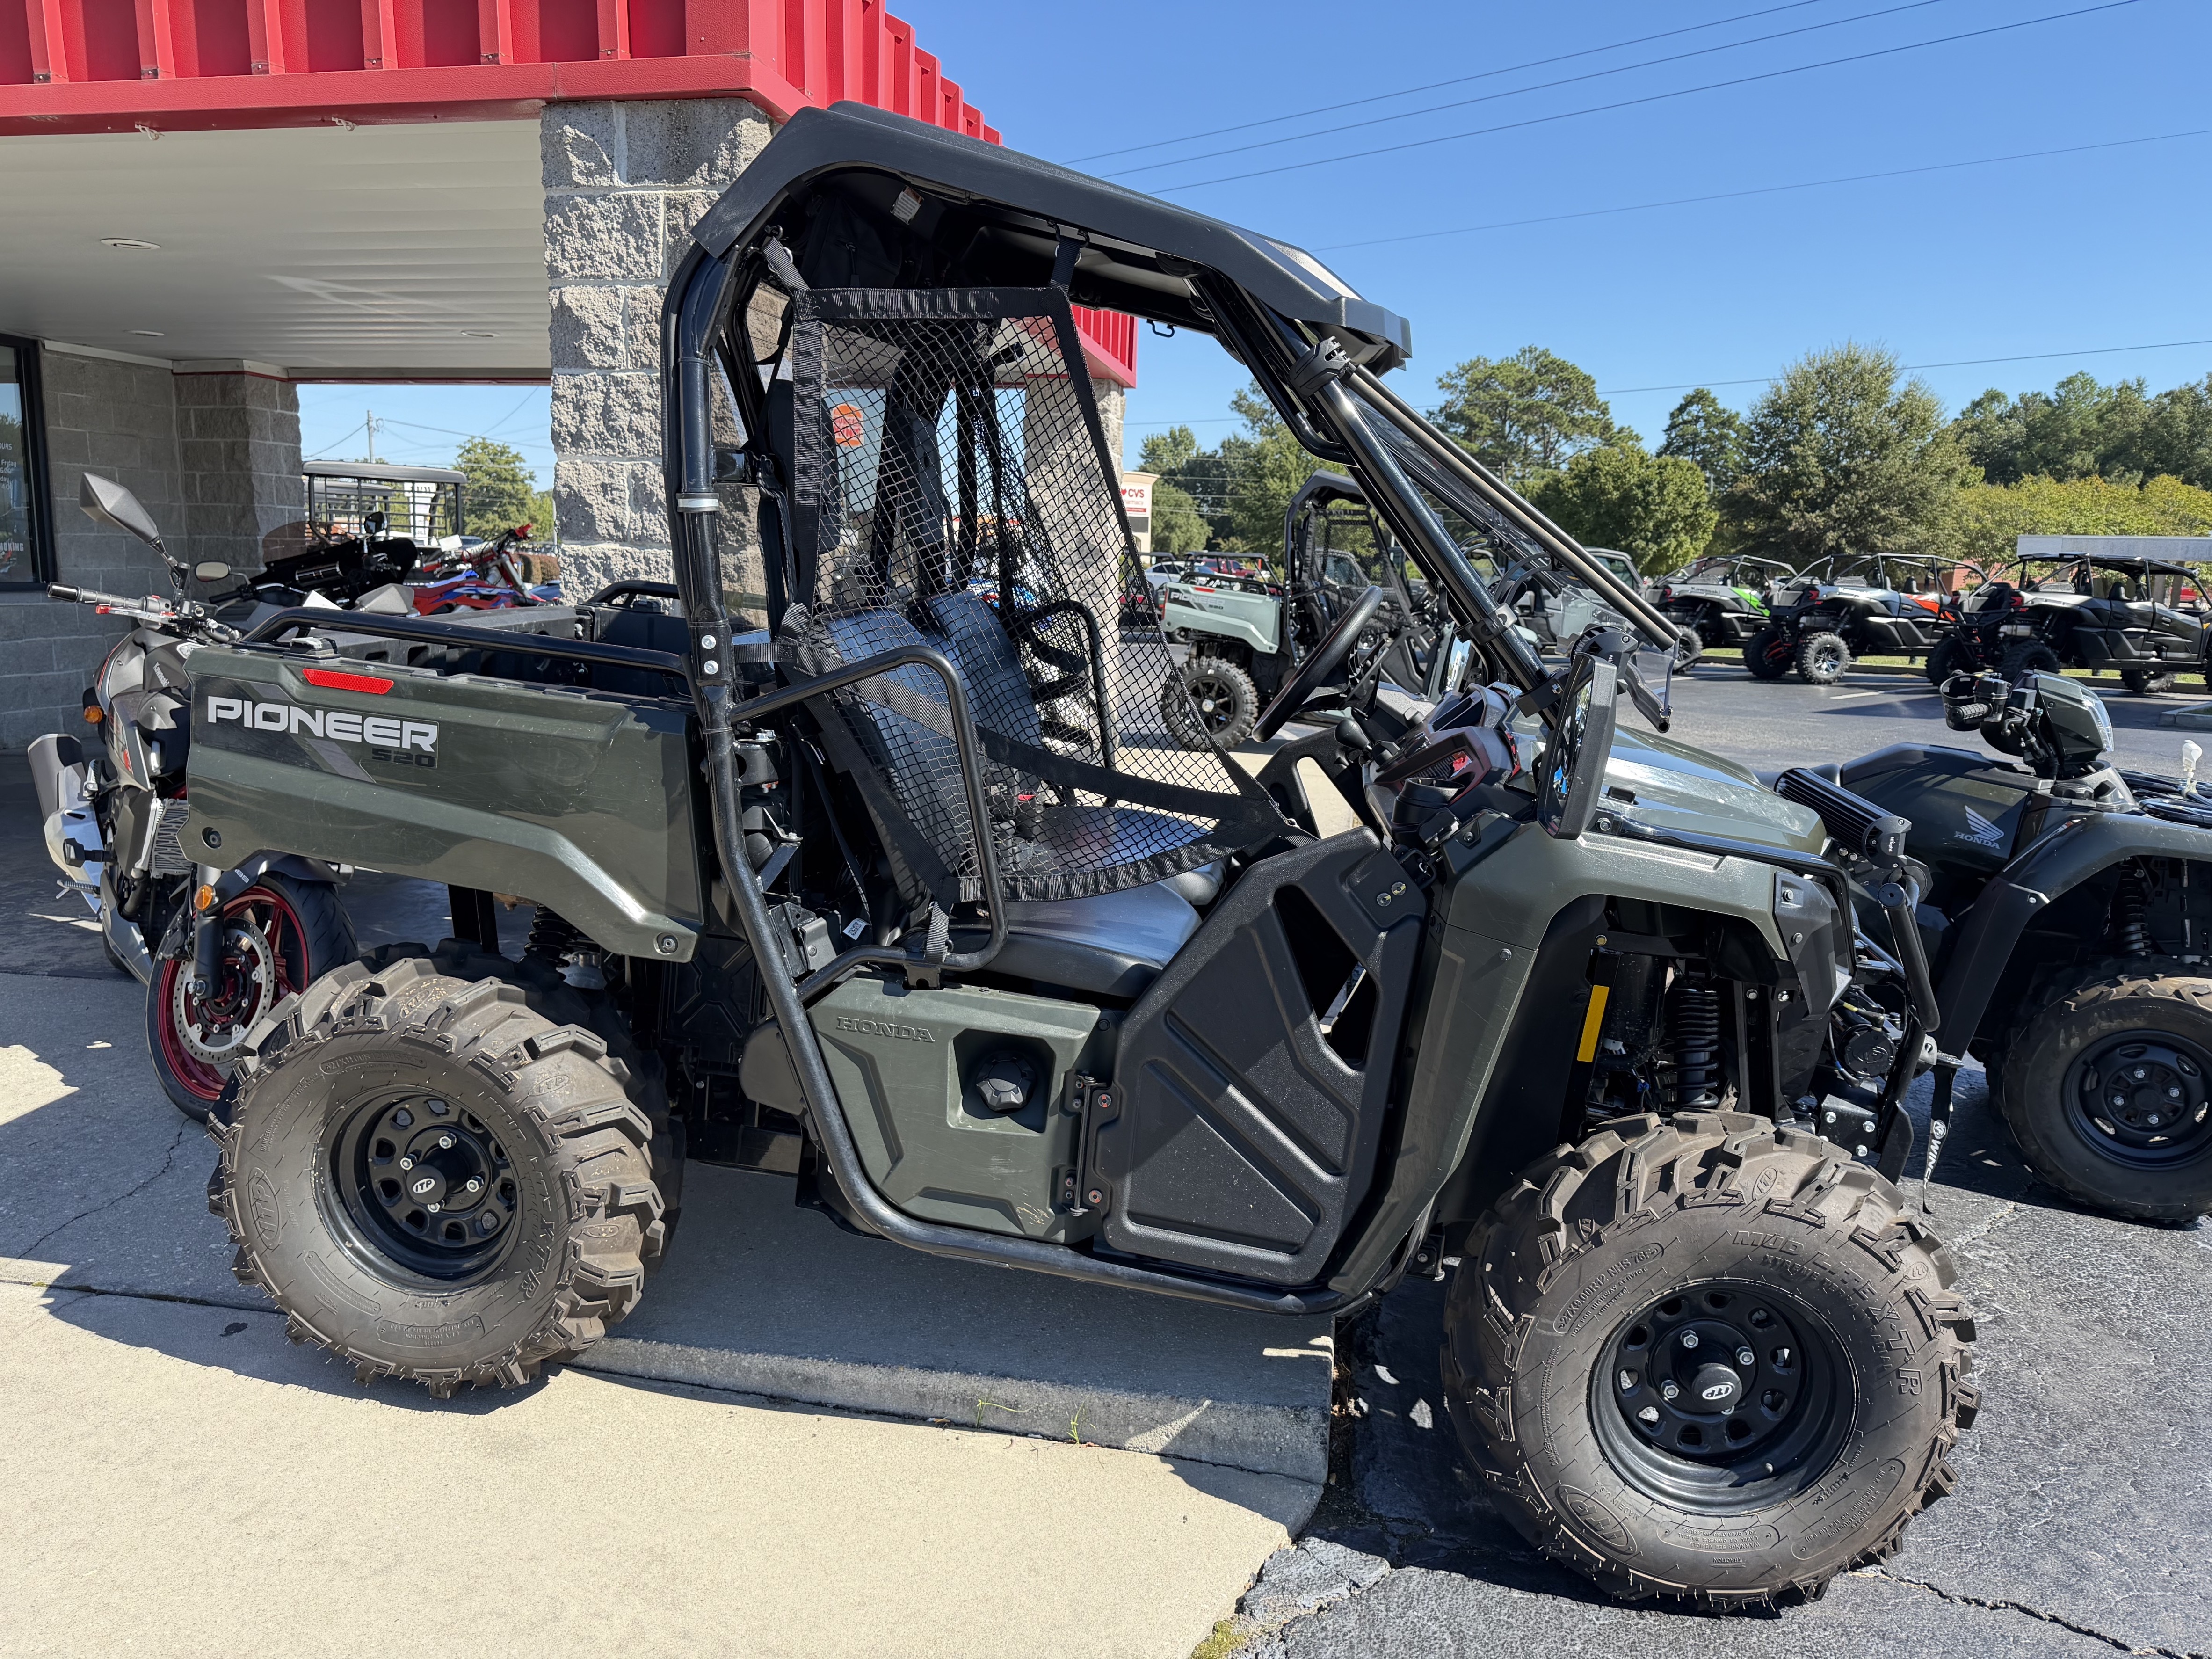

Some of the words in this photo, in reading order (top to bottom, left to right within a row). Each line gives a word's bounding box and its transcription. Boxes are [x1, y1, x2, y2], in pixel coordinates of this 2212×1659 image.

[1128, 488, 1144, 498] CVS
[1170, 591, 1225, 605] PIONEER
[1690, 586, 1720, 595] Kawasaki
[153, 662, 170, 687] Kawasaki
[208, 696, 438, 752] PIONEER
[371, 747, 436, 768] 520
[1954, 830, 2001, 850] HONDA
[235, 869, 250, 883] BS
[836, 1016, 935, 1043] HONDA
[538, 1076, 564, 1093] ITP
[415, 1179, 432, 1192] ITP
[1756, 1170, 1774, 1194] ITP
[251, 1183, 278, 1233] ITP
[1732, 1230, 1805, 1256] MUD
[1606, 1258, 1632, 1278] NHS
[1631, 1248, 1654, 1264] 76F
[1760, 1254, 1820, 1278] XTREME
[1570, 1323, 1582, 1337] NOT
[1581, 1312, 1592, 1323] FOR
[1590, 1285, 1618, 1310] HIGHWAY
[1618, 1266, 1648, 1286] SERVICE
[1705, 1386, 1730, 1398] ITP
[1867, 1495, 1877, 1506] PLY
[1570, 1499, 1625, 1540] ITP
[1617, 1503, 1641, 1521] MADE
[1827, 1506, 1867, 1538] CONSTRUCTION
[1677, 1532, 1700, 1542] MANUAL
[1689, 1541, 1713, 1550] VEHICLE
[1728, 1541, 1761, 1550] WARNING:
